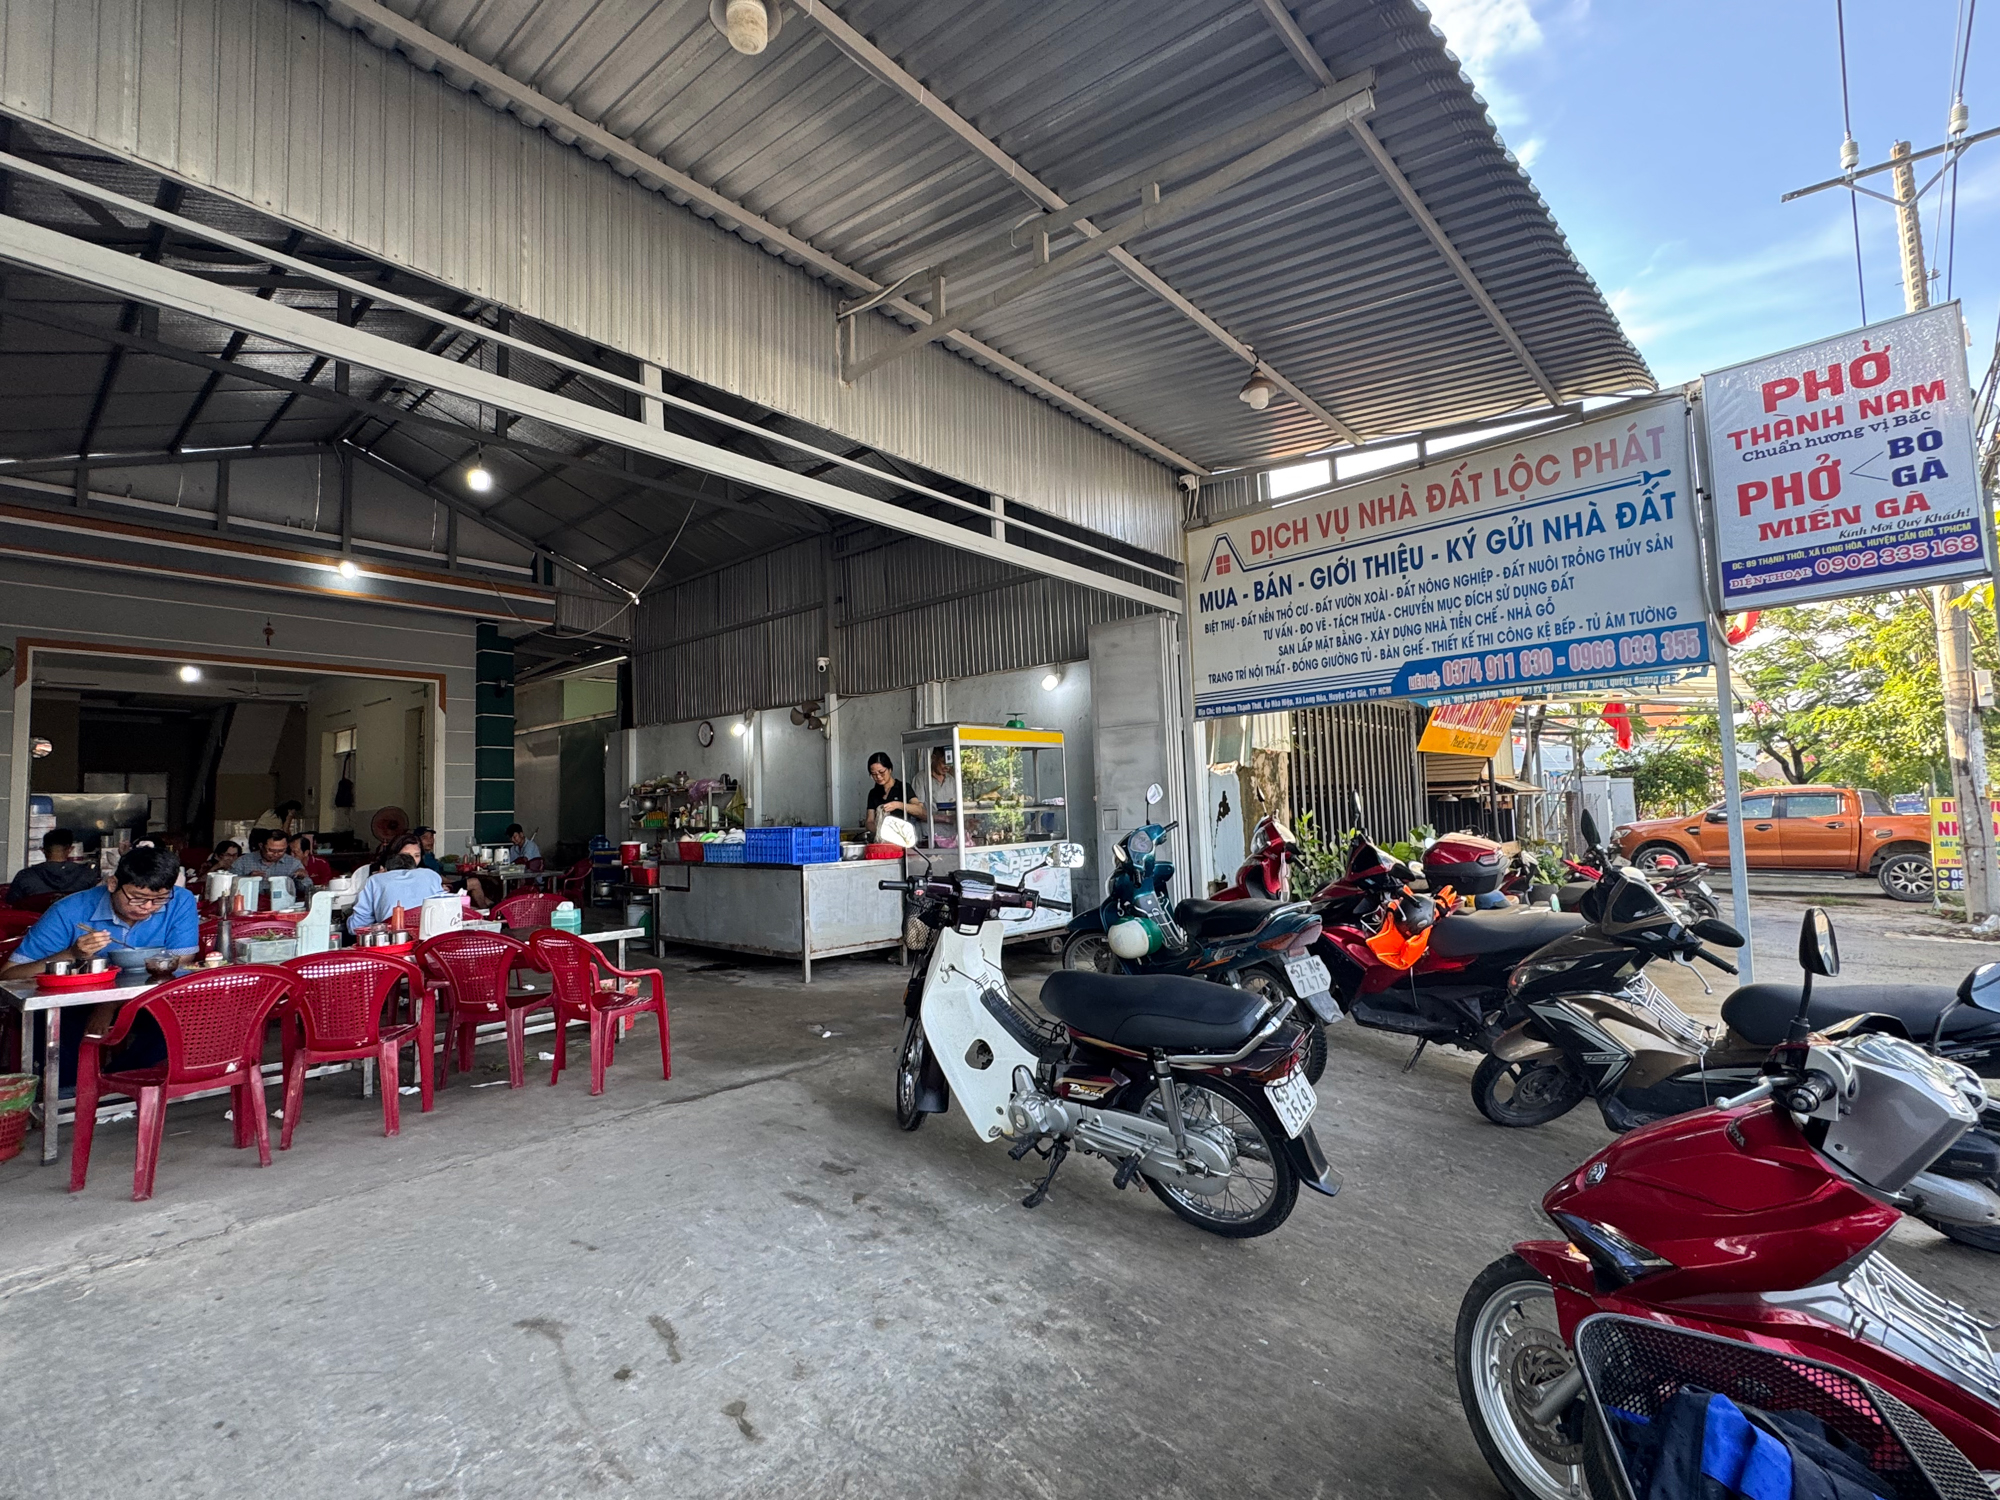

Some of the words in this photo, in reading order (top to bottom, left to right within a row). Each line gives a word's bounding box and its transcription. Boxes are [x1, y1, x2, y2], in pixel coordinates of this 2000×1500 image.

[1762, 339, 1891, 414] PHỞ
[1727, 405, 1844, 451] THÀNH
[1859, 379, 1946, 420] NAM
[1742, 439, 1802, 463] Chuẩn
[1804, 426, 1865, 449] hương
[1868, 417, 1889, 434] vị
[1892, 408, 1932, 428] Bắc
[1887, 427, 1944, 460] BÒ
[1251, 517, 1309, 560] DỊCH
[1316, 506, 1350, 543] VỤ
[1358, 483, 1418, 529] NHÀ
[1426, 461, 1483, 512] ĐẤT
[1494, 453, 1561, 501] LỘC
[1573, 422, 1665, 479] PHÁT
[1736, 453, 1842, 517] PHỞ
[1891, 456, 1949, 487] GÀ
[1746, 559, 1757, 568] 89
[1758, 554, 1785, 566] THẠNH
[1821, 543, 1844, 555] LONG
[1867, 534, 1897, 547] HUYỆN
[1938, 522, 1972, 535] TPHCM
[1758, 504, 1862, 542] MIẾN
[1875, 490, 1931, 519] GÀ
[1200, 586, 1238, 613] MUA
[1254, 571, 1293, 602] BÁN
[1310, 555, 1357, 590] GIỚI
[1363, 542, 1424, 580] THIỆU
[1446, 527, 1478, 563] KÝ
[1486, 515, 1534, 555] GỬI
[1543, 500, 1606, 544] NHÀ
[1616, 481, 1677, 530] ĐẤT
[1815, 551, 1878, 575] 0902
[1880, 542, 1930, 566] 335
[1931, 534, 1979, 557] 168
[1204, 621, 1219, 636] BIỆT
[1220, 617, 1235, 632] THỰ
[1241, 610, 1257, 627] ĐẤT
[1259, 606, 1274, 624] NỀN
[1276, 601, 1293, 620] THỔ
[1296, 602, 1309, 617] CƯ
[1315, 595, 1333, 613] ĐẤT
[1334, 591, 1361, 609] VƯỜN
[1364, 587, 1388, 605] XOÀI
[1396, 579, 1416, 598] ĐẤT
[1418, 577, 1450, 595] NÔNG
[1453, 567, 1493, 588] NGHIỆP
[1503, 558, 1525, 579] ĐẤT
[1528, 555, 1558, 575] NUÔI
[1562, 546, 1605, 569] TRỒNG
[1609, 538, 1642, 560] THỦY
[1646, 533, 1674, 553] SẢN
[1263, 626, 1274, 641] TƯ
[1275, 621, 1293, 639] VẤN
[1300, 621, 1313, 634] ĐO
[1316, 616, 1327, 632] VẼ
[1333, 613, 1359, 629] TÁCH
[1361, 606, 1386, 624] THỬA
[1394, 595, 1434, 619] CHUYỂN
[1437, 595, 1462, 613] MỤC
[1465, 588, 1493, 607] ĐÍCH
[1496, 583, 1511, 601] SỬ
[1513, 581, 1547, 602] DỤNG
[1551, 571, 1575, 593] ĐẤT
[1208, 671, 1233, 684] TRANG
[1235, 666, 1247, 680] TRÍ
[1249, 664, 1264, 681] NỘI
[1265, 659, 1286, 676] THẤT
[1292, 657, 1318, 673] ĐÓNG
[1321, 651, 1359, 669] GIƯỜNG
[1361, 646, 1372, 663] TỦ
[1380, 643, 1400, 660] BÀN
[1403, 637, 1424, 657] GHẾ
[1432, 633, 1458, 652] THIẾT
[1462, 629, 1476, 649] KẾ
[1477, 632, 1494, 647] THI
[1497, 625, 1534, 644] CÔNG
[1537, 621, 1551, 641] KỆ
[1554, 616, 1576, 636] BẾP
[1586, 612, 1600, 632] TỦ
[1605, 611, 1626, 629] ÂM
[1629, 605, 1678, 625] TƯỜNG
[1278, 643, 1295, 657] SAN
[1297, 636, 1313, 653] LẤP
[1315, 636, 1334, 653] MẶT
[1336, 629, 1362, 648] BẰNG
[1370, 626, 1390, 642] XÂY
[1393, 623, 1422, 642] DỰNG
[1425, 616, 1447, 634] NHÀ
[1450, 610, 1472, 630] TIỀN
[1475, 605, 1499, 625] CHẾ
[1507, 602, 1532, 621] NHÀ
[1536, 596, 1555, 616] GỖ
[1408, 672, 1426, 690] LIÊN
[1442, 656, 1483, 686] 0374
[1485, 652, 1515, 682] 911
[1519, 647, 1554, 678] 830
[1568, 639, 1616, 672] 0966
[1619, 633, 1657, 666] 033
[1660, 628, 1701, 661] 355
[1377, 686, 1392, 696] HCM
[1298, 973, 1329, 994] 7476
